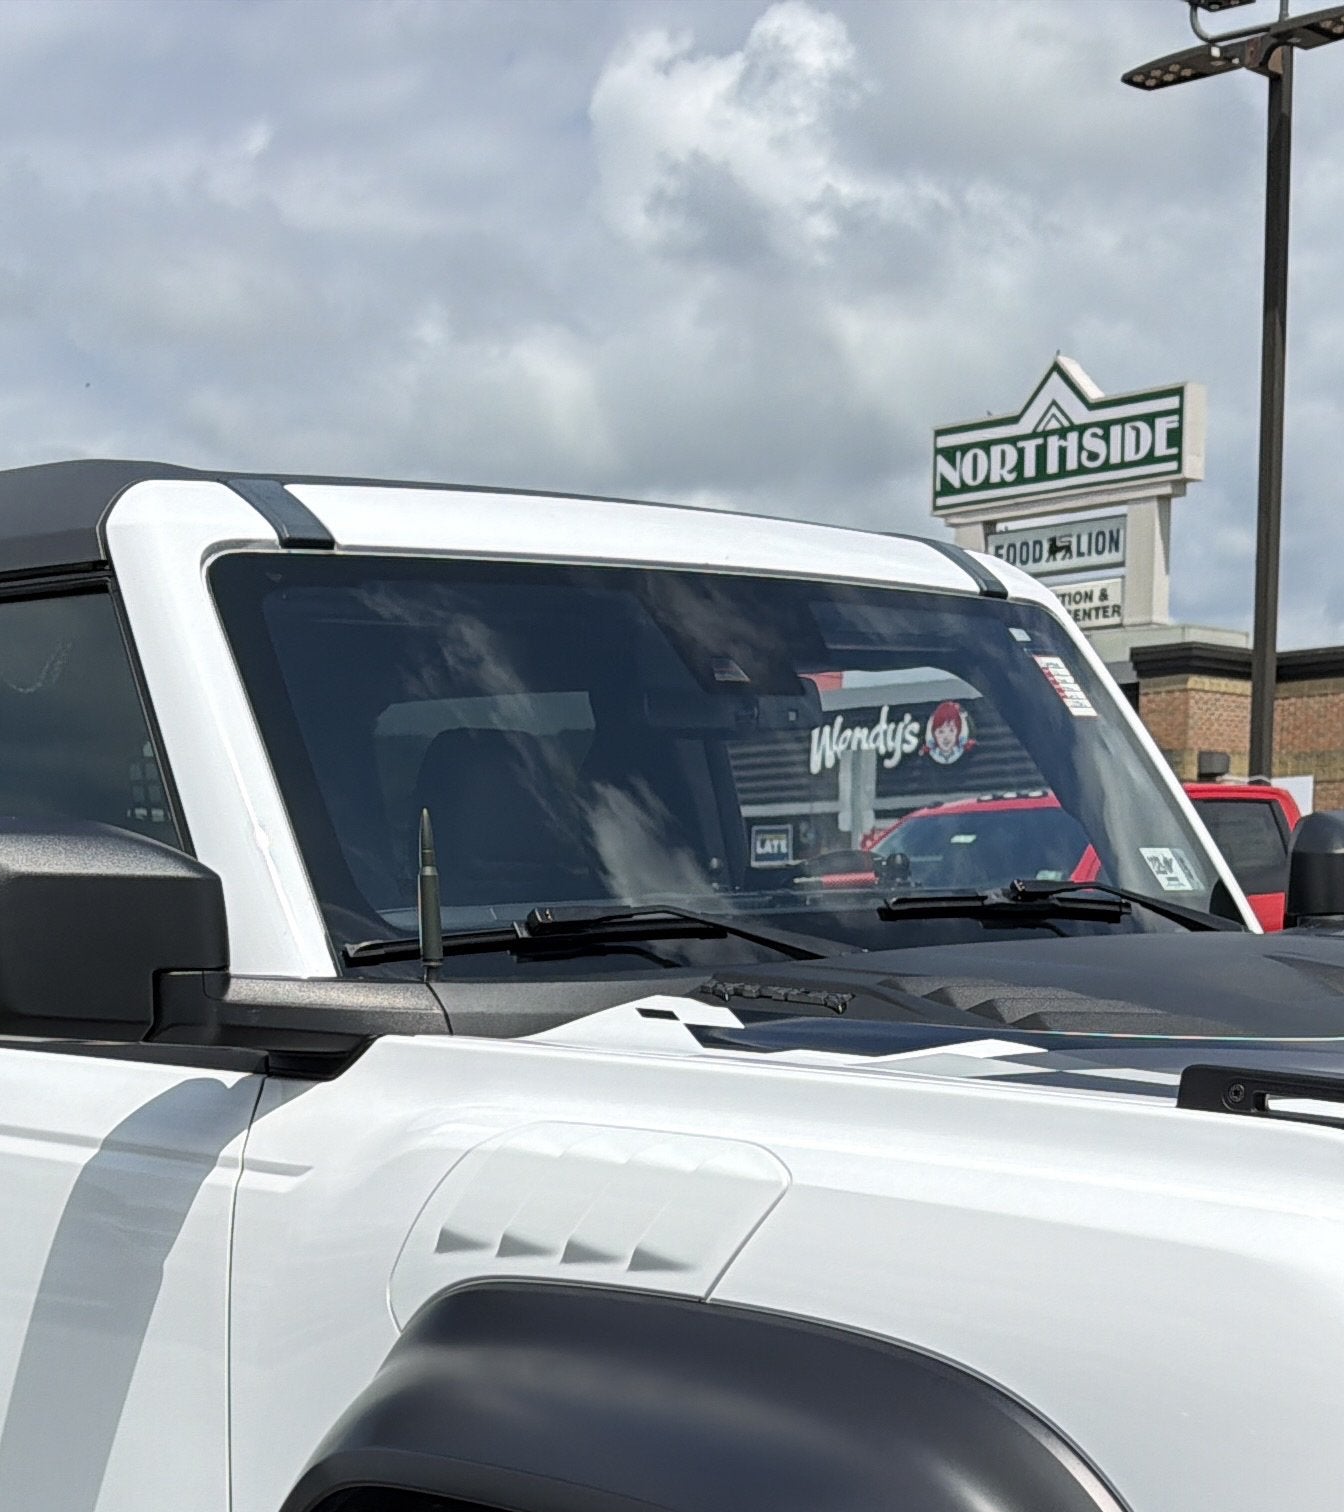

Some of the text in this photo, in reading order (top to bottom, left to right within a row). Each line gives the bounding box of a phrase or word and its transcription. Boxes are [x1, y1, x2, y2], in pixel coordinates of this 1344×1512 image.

[935, 415, 1180, 492] NORTHSIDE
[994, 528, 1121, 567] FOOD LION
[1099, 588, 1109, 602] &
[810, 705, 921, 775] Wendy's
